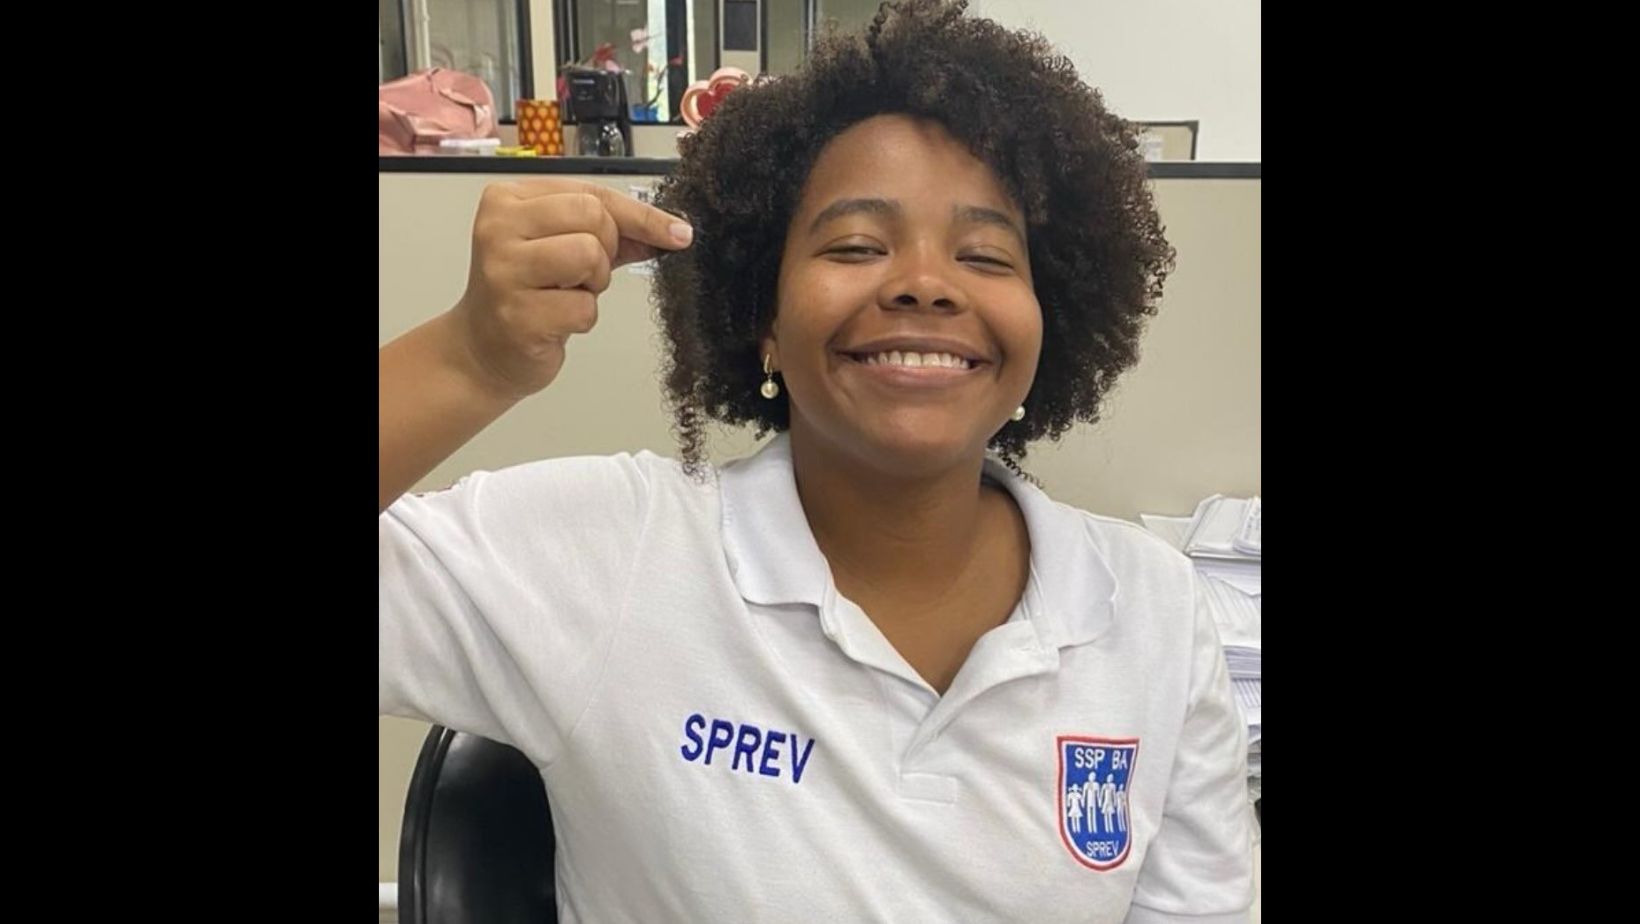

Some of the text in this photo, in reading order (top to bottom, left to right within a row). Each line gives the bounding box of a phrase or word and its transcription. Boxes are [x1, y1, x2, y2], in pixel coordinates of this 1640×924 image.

[681, 713, 815, 784] SPREV
[1074, 747, 1128, 770] SSP BA
[1086, 840, 1120, 858] SPREV
